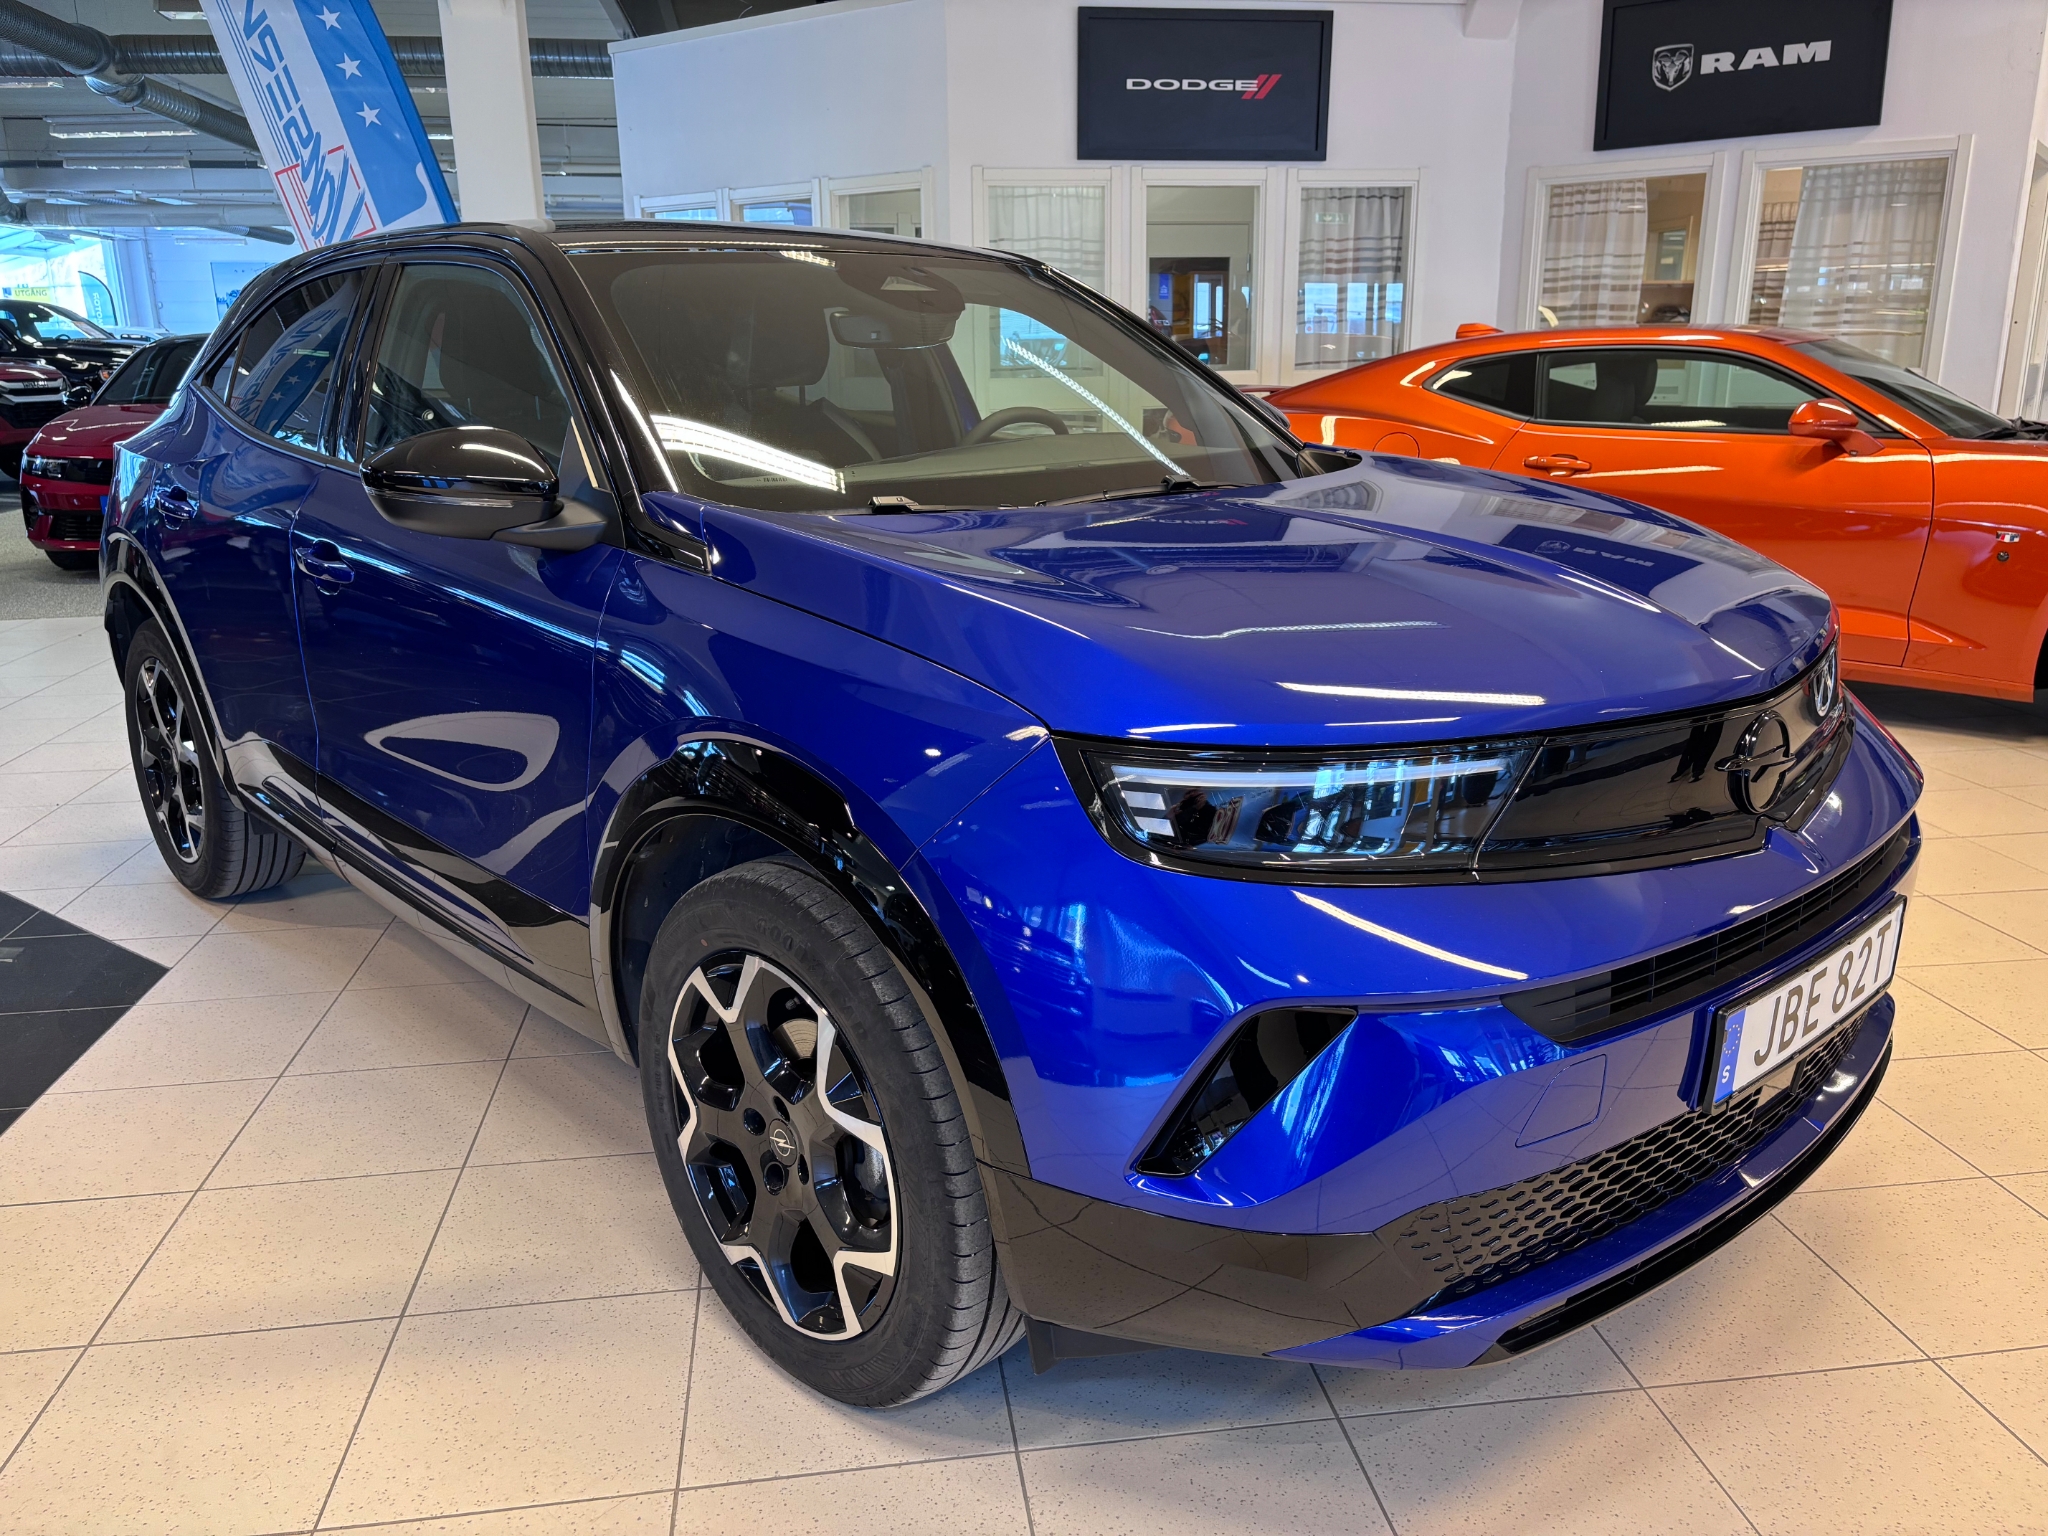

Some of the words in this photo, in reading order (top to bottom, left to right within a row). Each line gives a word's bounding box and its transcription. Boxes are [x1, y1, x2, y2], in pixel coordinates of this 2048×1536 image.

[1700, 40, 1832, 75] RAM
[1126, 79, 1259, 91] DODGE
[14, 288, 48, 297] UTGÅNG
[1753, 966, 1828, 1067] JBE
[1831, 919, 1893, 1014] 82T
[1721, 1064, 1731, 1083] S
